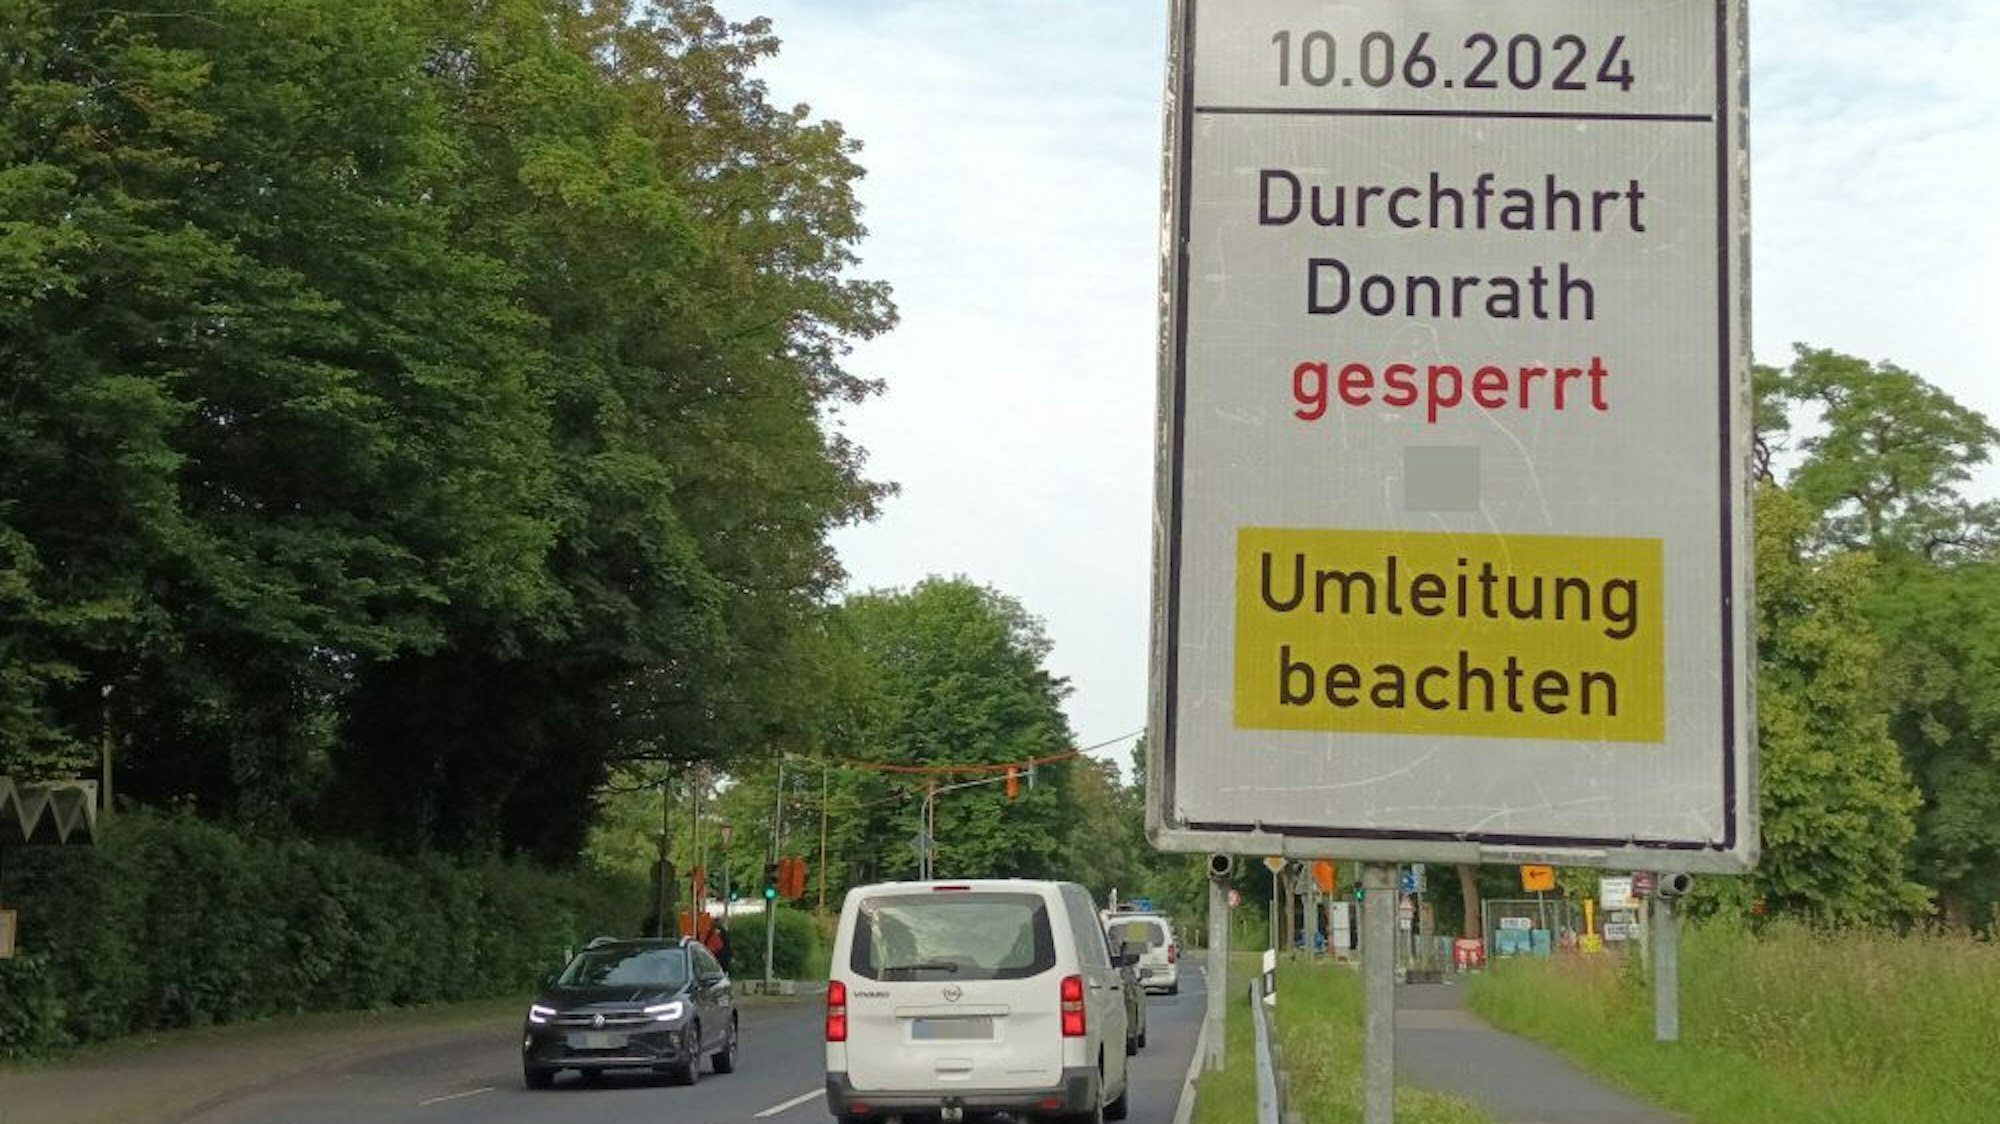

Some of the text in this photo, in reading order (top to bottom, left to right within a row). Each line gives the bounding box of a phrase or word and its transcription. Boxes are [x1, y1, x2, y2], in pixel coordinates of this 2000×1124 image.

[1271, 30, 1635, 92] 10.06.2024
[1258, 169, 1646, 233] Durchfahrt
[1307, 257, 1595, 321] Donrath
[1292, 357, 1608, 424] gesperrt
[1261, 552, 1637, 640] Umleitung
[1280, 645, 1617, 717] beachten
